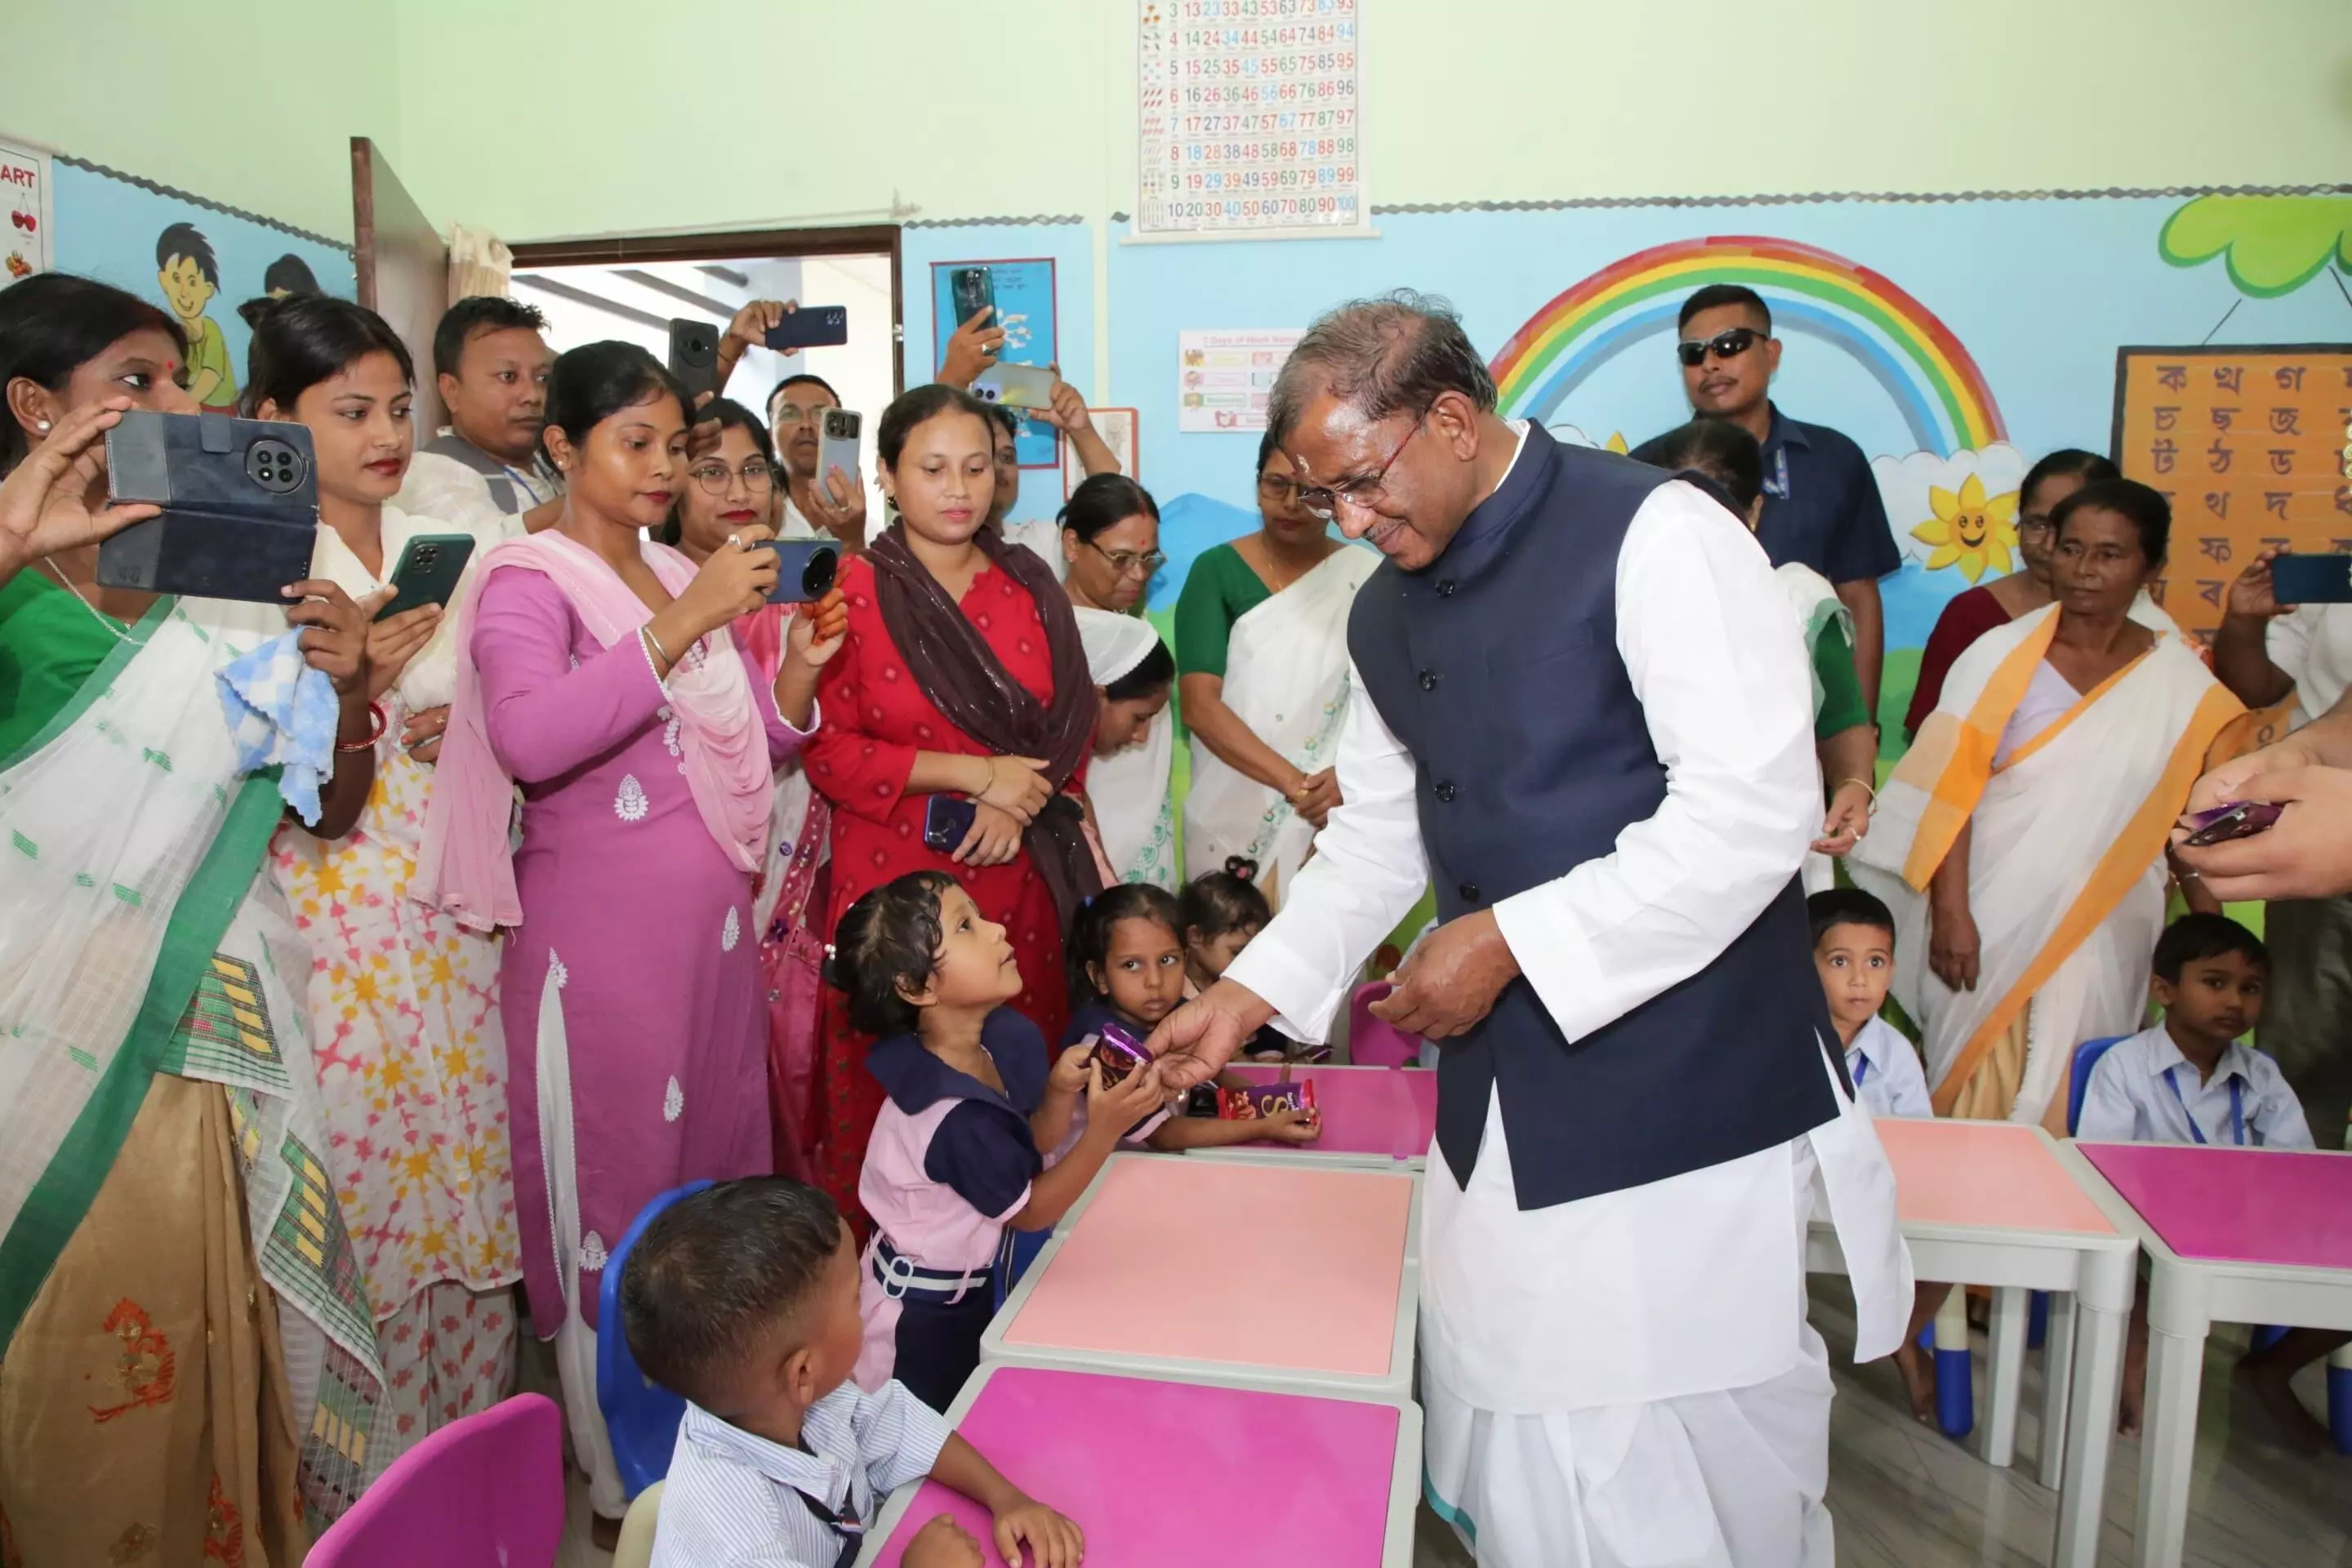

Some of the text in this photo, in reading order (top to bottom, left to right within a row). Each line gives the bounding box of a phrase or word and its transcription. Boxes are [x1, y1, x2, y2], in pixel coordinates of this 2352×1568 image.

[1169, 3, 1178, 17] 3
[1185, 2, 1200, 16] 13
[1204, 2, 1220, 16] 23
[1223, 2, 1240, 16] 33
[1241, 2, 1258, 16] 43
[1260, 2, 1277, 16] 53
[1279, 0, 1296, 14] 63
[1298, 0, 1316, 11] 73
[1169, 24, 1354, 46] 4 14 24 34 44 54 64 74 84 94
[1170, 53, 1354, 75] 5 15 25 35 45 55 65 75 85 95
[1170, 81, 1354, 102] 6 16 26 36 46 56 66 76 86 96
[1170, 109, 1354, 131] 7 17 27 37 47 57 67 77 87 97
[1170, 138, 1354, 159] 8 18 28 38 48 58 68 78 88 98
[1, 164, 35, 189] ART
[1170, 167, 1354, 189] 9 19 29 39 49 59 69 79 89 99
[1169, 197, 1356, 217] 10 20 30 40 50 60 70 80 90 100
[2156, 365, 2187, 394] ক
[2274, 366, 2306, 392] গ
[2153, 407, 2301, 435] চ ছ জ
[2150, 438, 2179, 474] ট
[2207, 439, 2234, 474] ঠ
[2268, 450, 2296, 475] ড
[2264, 492, 2292, 520] দ
[2198, 537, 2232, 564] ফ
